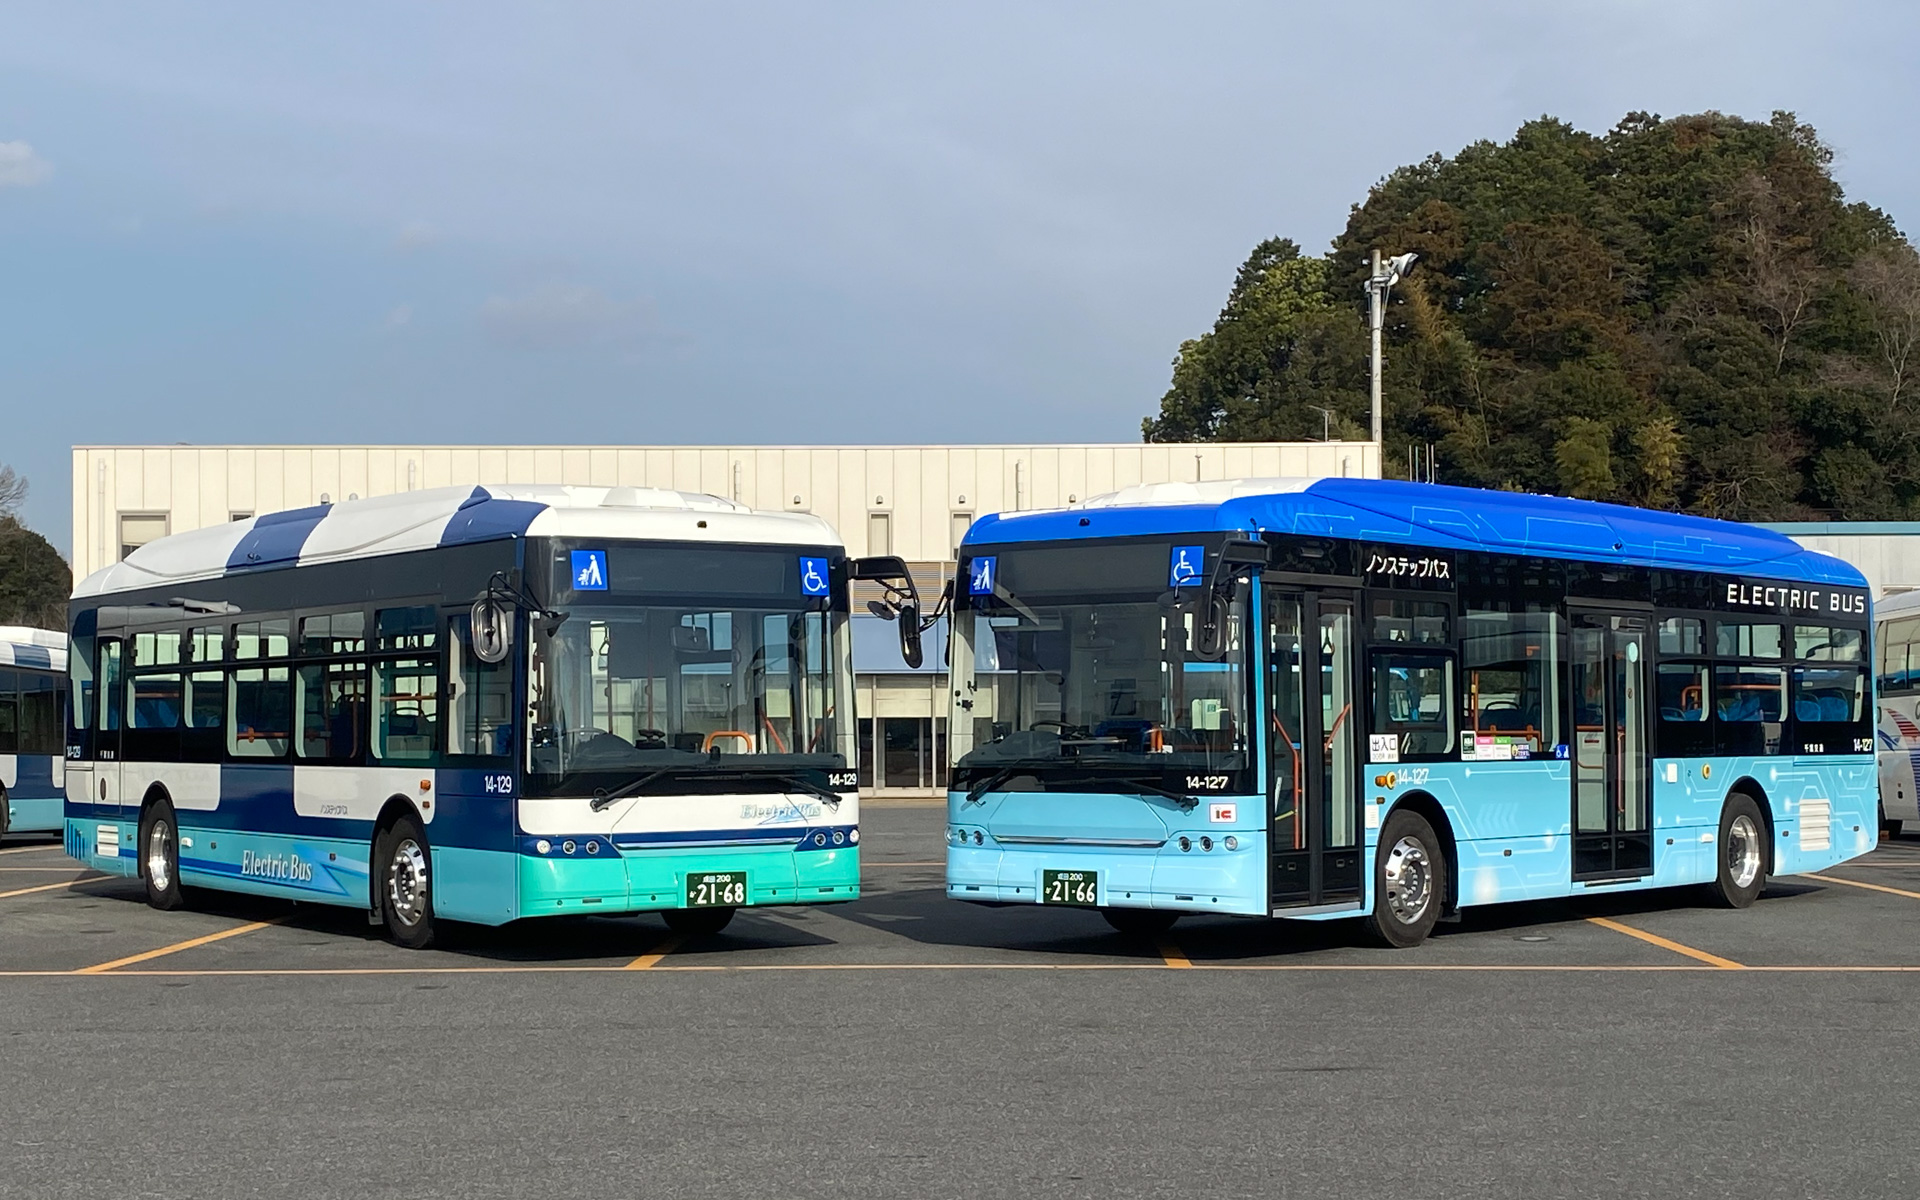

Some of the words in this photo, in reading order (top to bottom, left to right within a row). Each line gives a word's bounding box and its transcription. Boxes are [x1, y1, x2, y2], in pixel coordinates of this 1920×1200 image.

[1727, 583, 1820, 610] ELECTRIC
[1830, 593, 1865, 613] BUS
[1371, 736, 1396, 751] 出入口
[484, 775, 512, 794] 14-129
[828, 773, 857, 786] 14-129
[1185, 775, 1229, 789] 14-127
[1397, 768, 1429, 785] 14-127
[741, 804, 795, 819] Electric
[797, 804, 822, 817] Bus
[241, 850, 289, 878] Electric
[289, 854, 312, 881] Bus
[716, 874, 731, 883] 200
[1069, 872, 1083, 881] 200
[696, 882, 744, 905] 21-68
[1051, 880, 1096, 903] 21-66
